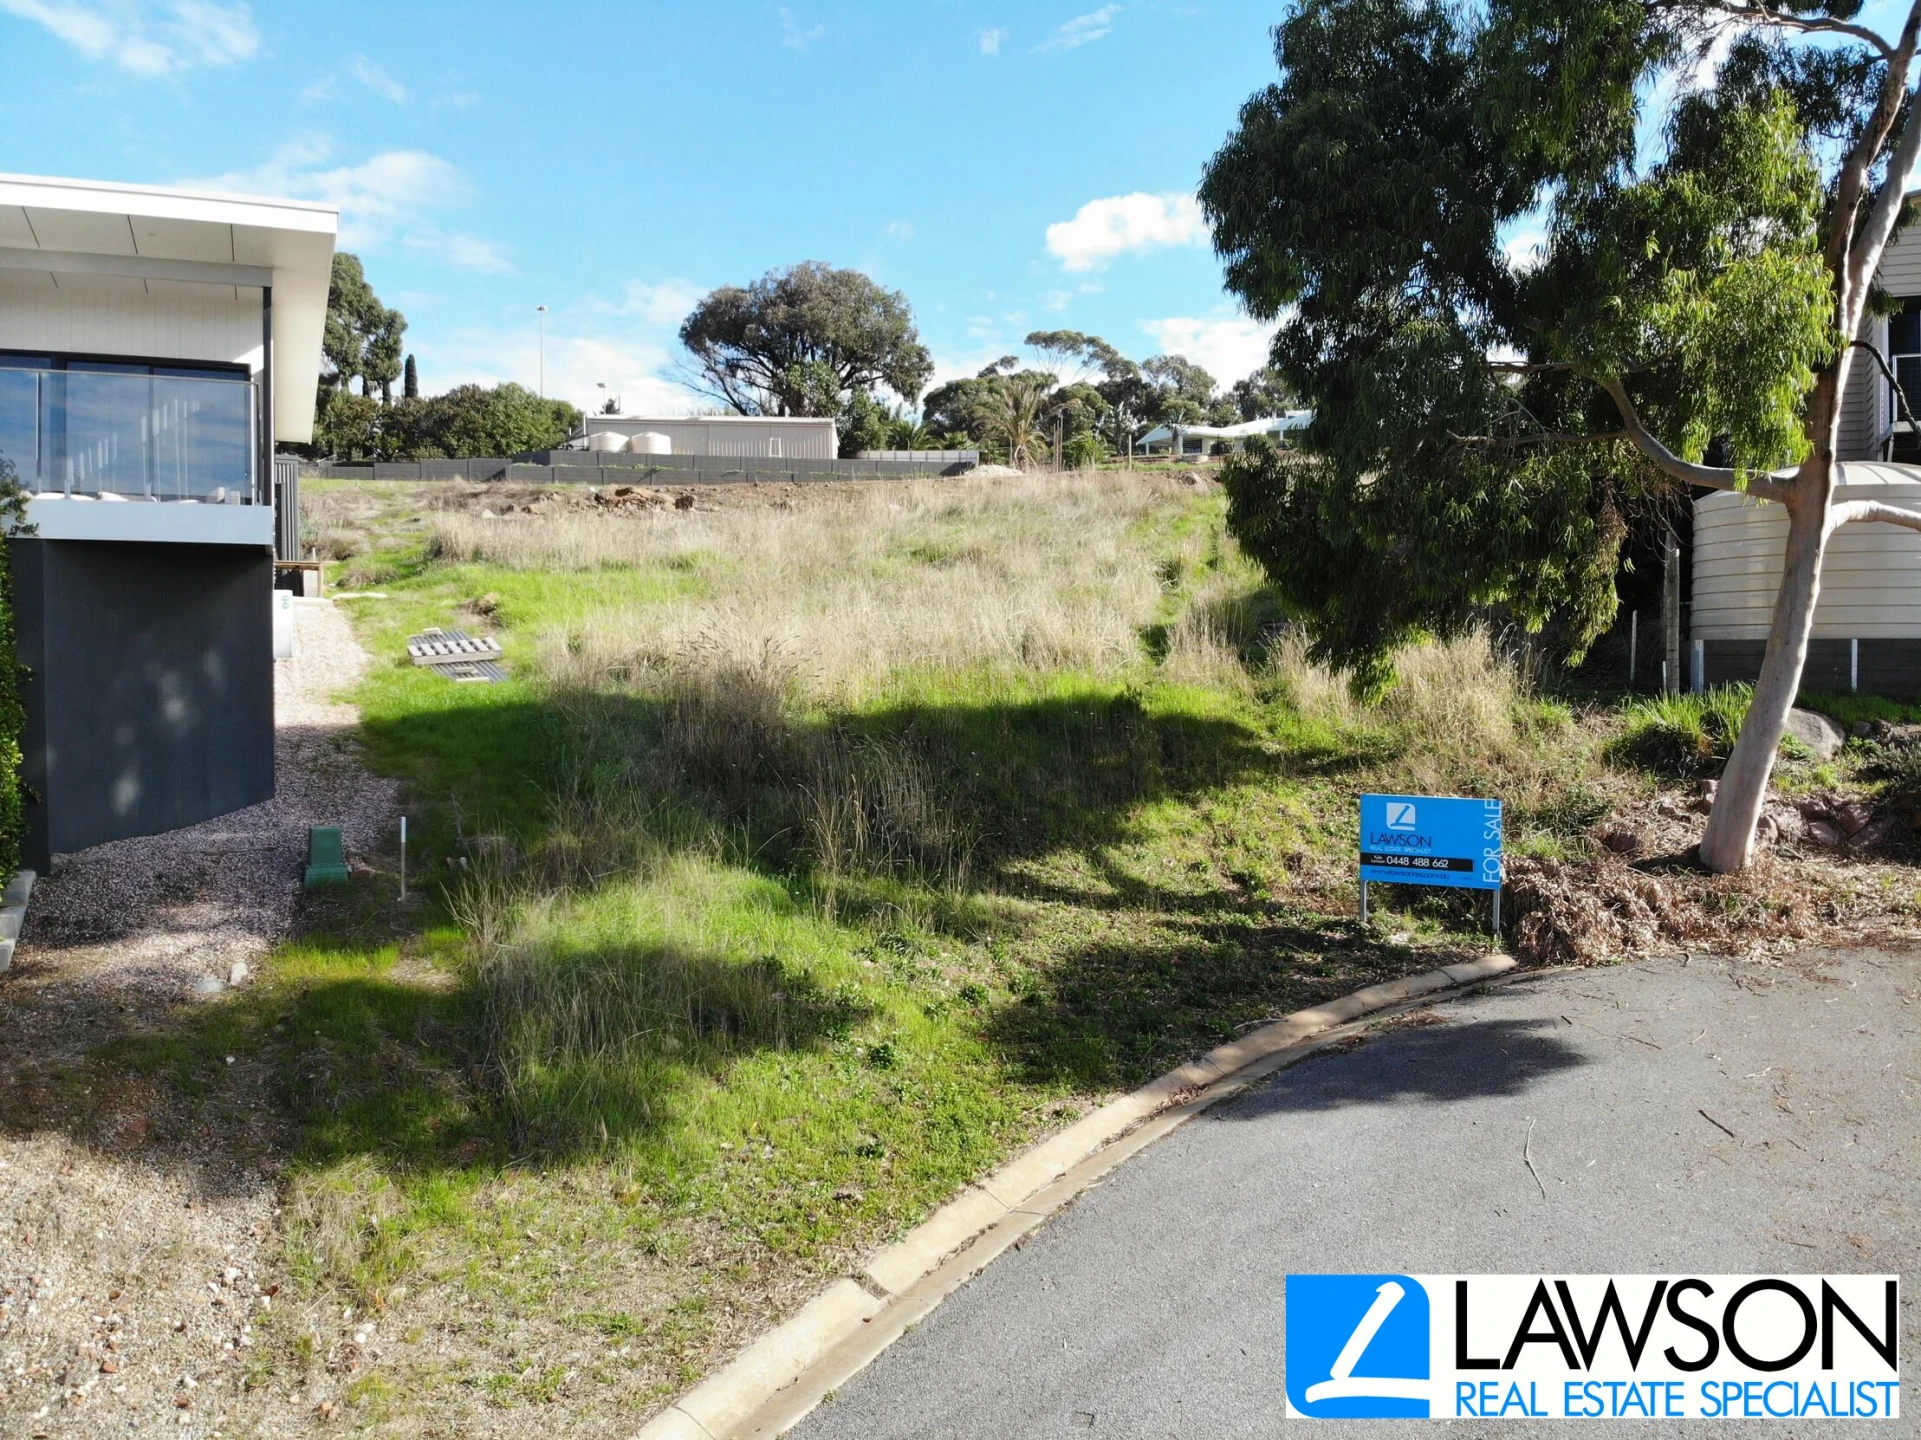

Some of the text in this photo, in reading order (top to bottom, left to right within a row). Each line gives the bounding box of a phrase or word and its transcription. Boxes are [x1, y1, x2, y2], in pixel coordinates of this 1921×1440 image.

[1370, 832, 1432, 847] LAWSON
[1483, 800, 1502, 882] FOR SALE
[1386, 855, 1449, 868] 0448 488 662
